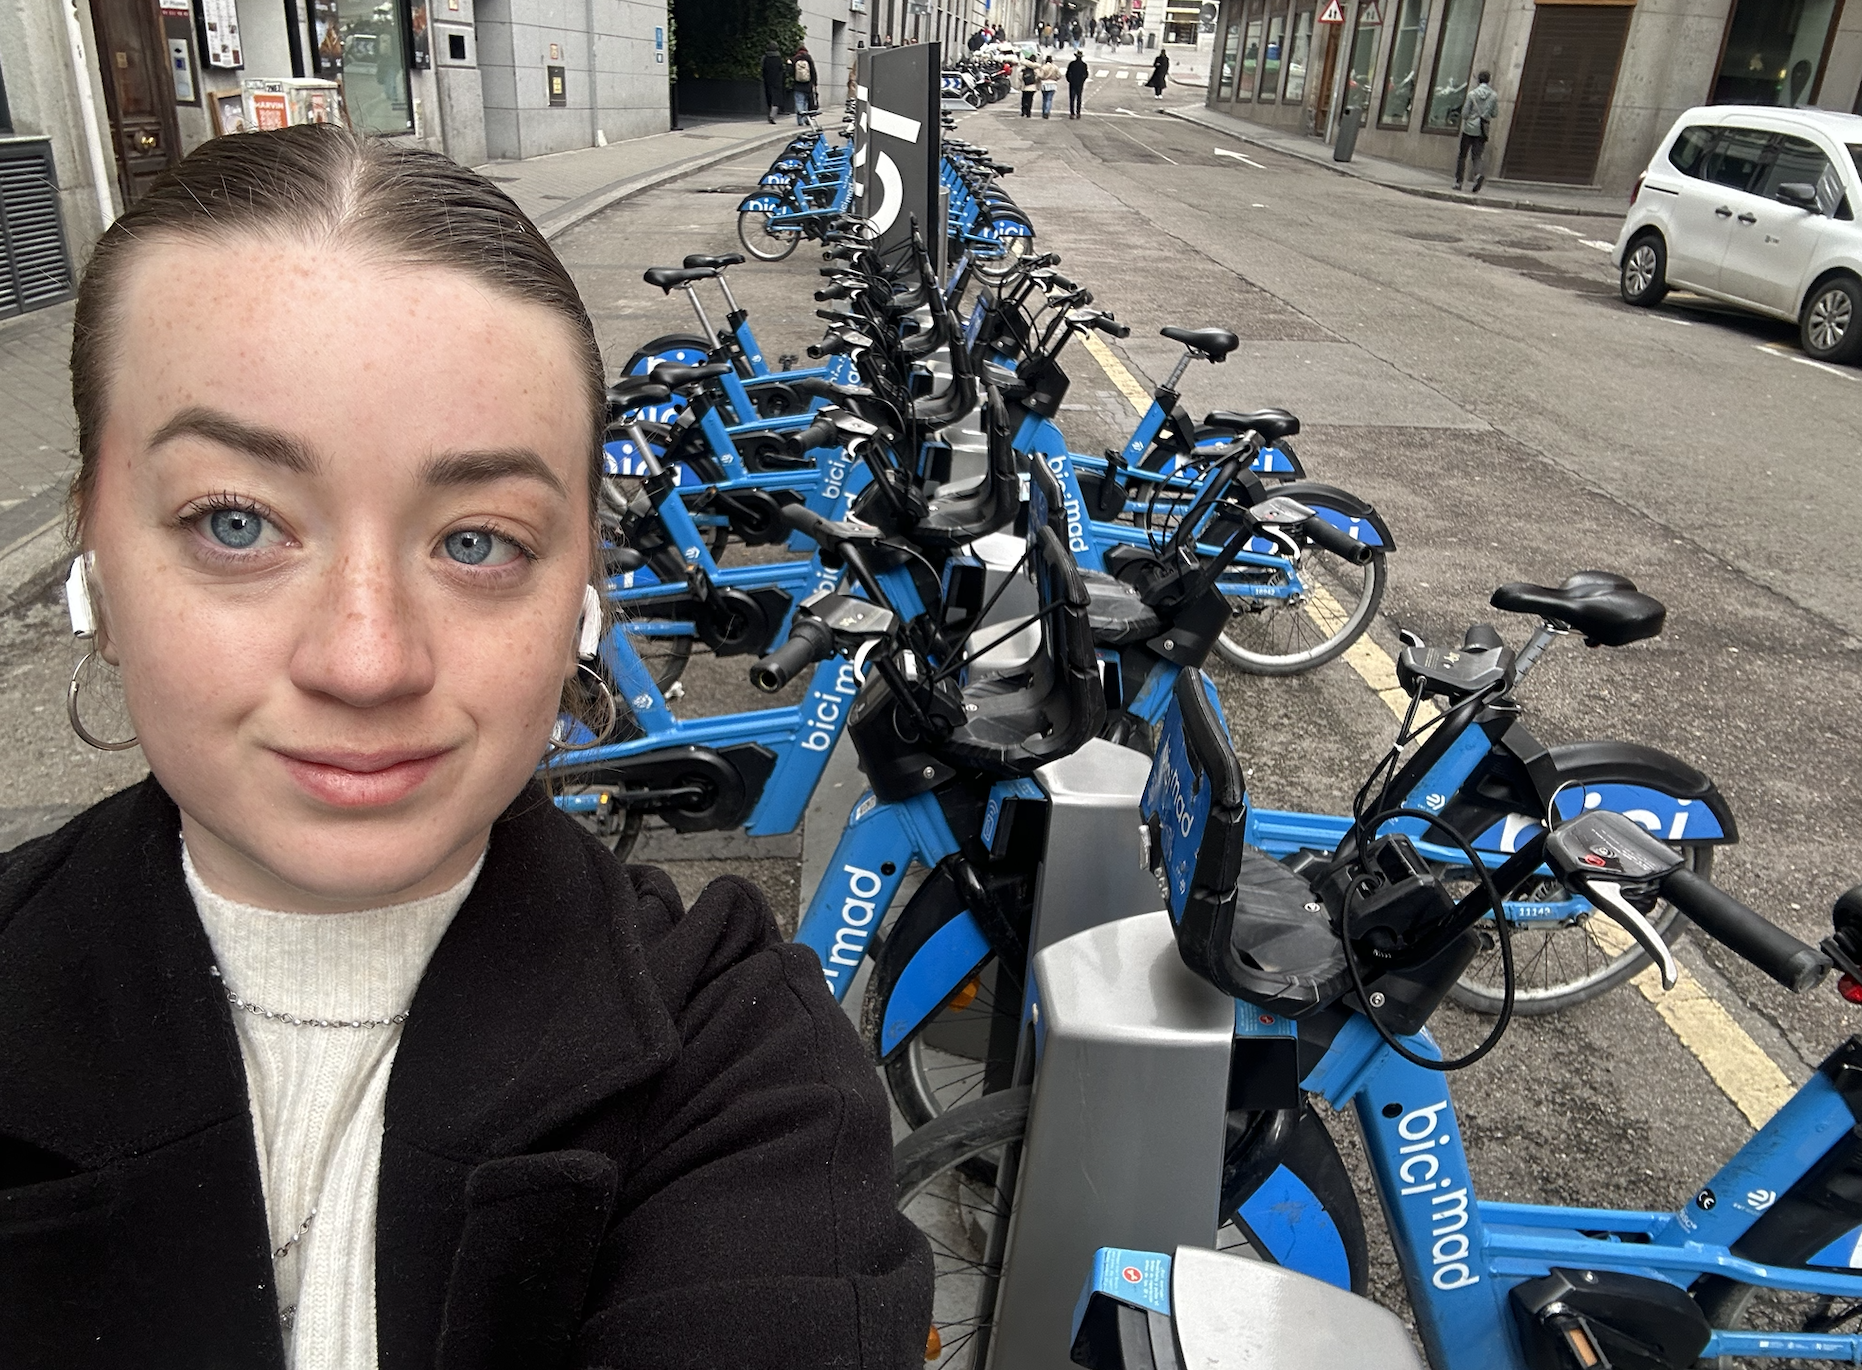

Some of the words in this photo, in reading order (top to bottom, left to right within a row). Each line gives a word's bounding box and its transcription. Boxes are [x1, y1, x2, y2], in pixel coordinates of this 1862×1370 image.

[801, 660, 857, 751] bicim
[822, 864, 882, 995] imad
[1398, 1100, 1480, 1290] bicimad
